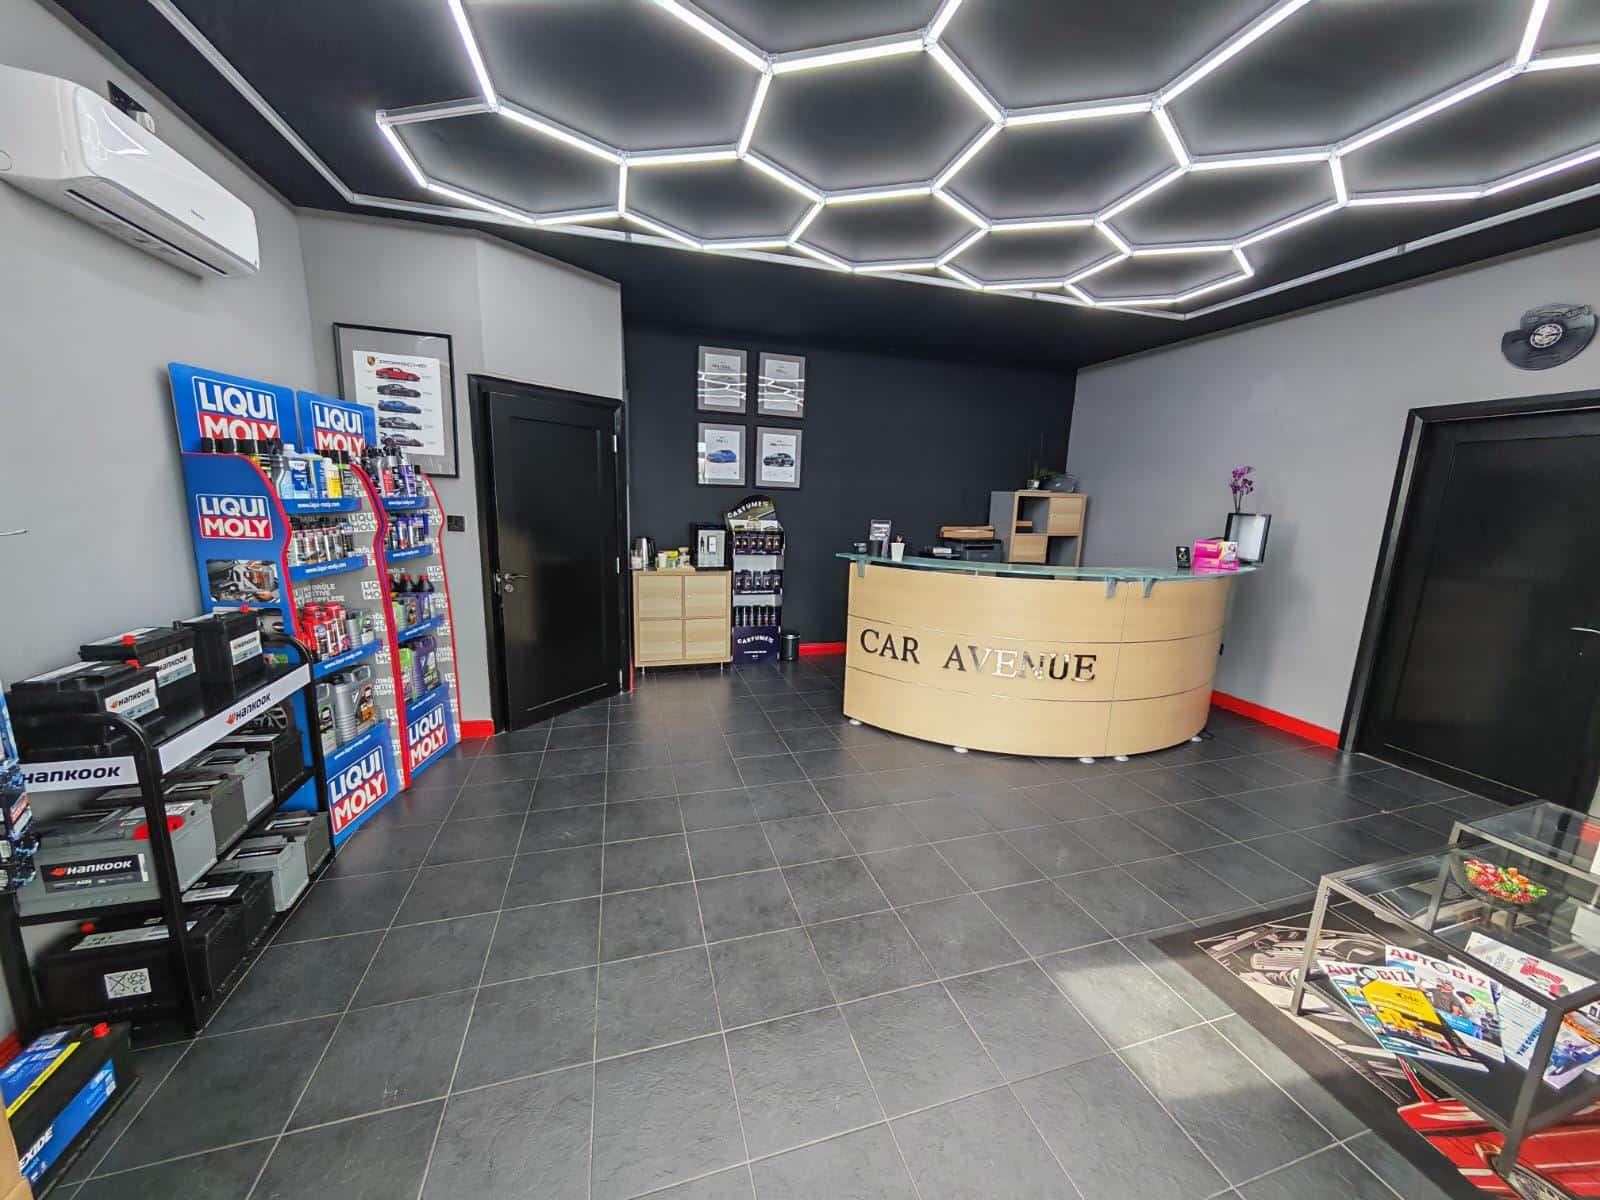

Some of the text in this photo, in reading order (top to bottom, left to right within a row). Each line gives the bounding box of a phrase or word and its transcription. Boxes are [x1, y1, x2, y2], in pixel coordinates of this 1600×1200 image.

[197, 381, 275, 421] LIQUI
[314, 404, 363, 435] LIQUI
[316, 431, 367, 459] MOLY
[200, 496, 266, 518] LIQUI
[202, 517, 271, 538] MOLY
[859, 627, 1097, 683] CAR AVENUE
[408, 707, 443, 746] LIQUI
[410, 726, 446, 768] MOLY
[330, 750, 382, 804] LIQUI
[333, 772, 385, 830] MOLY
[18, 1125, 54, 1169] EXIDE
